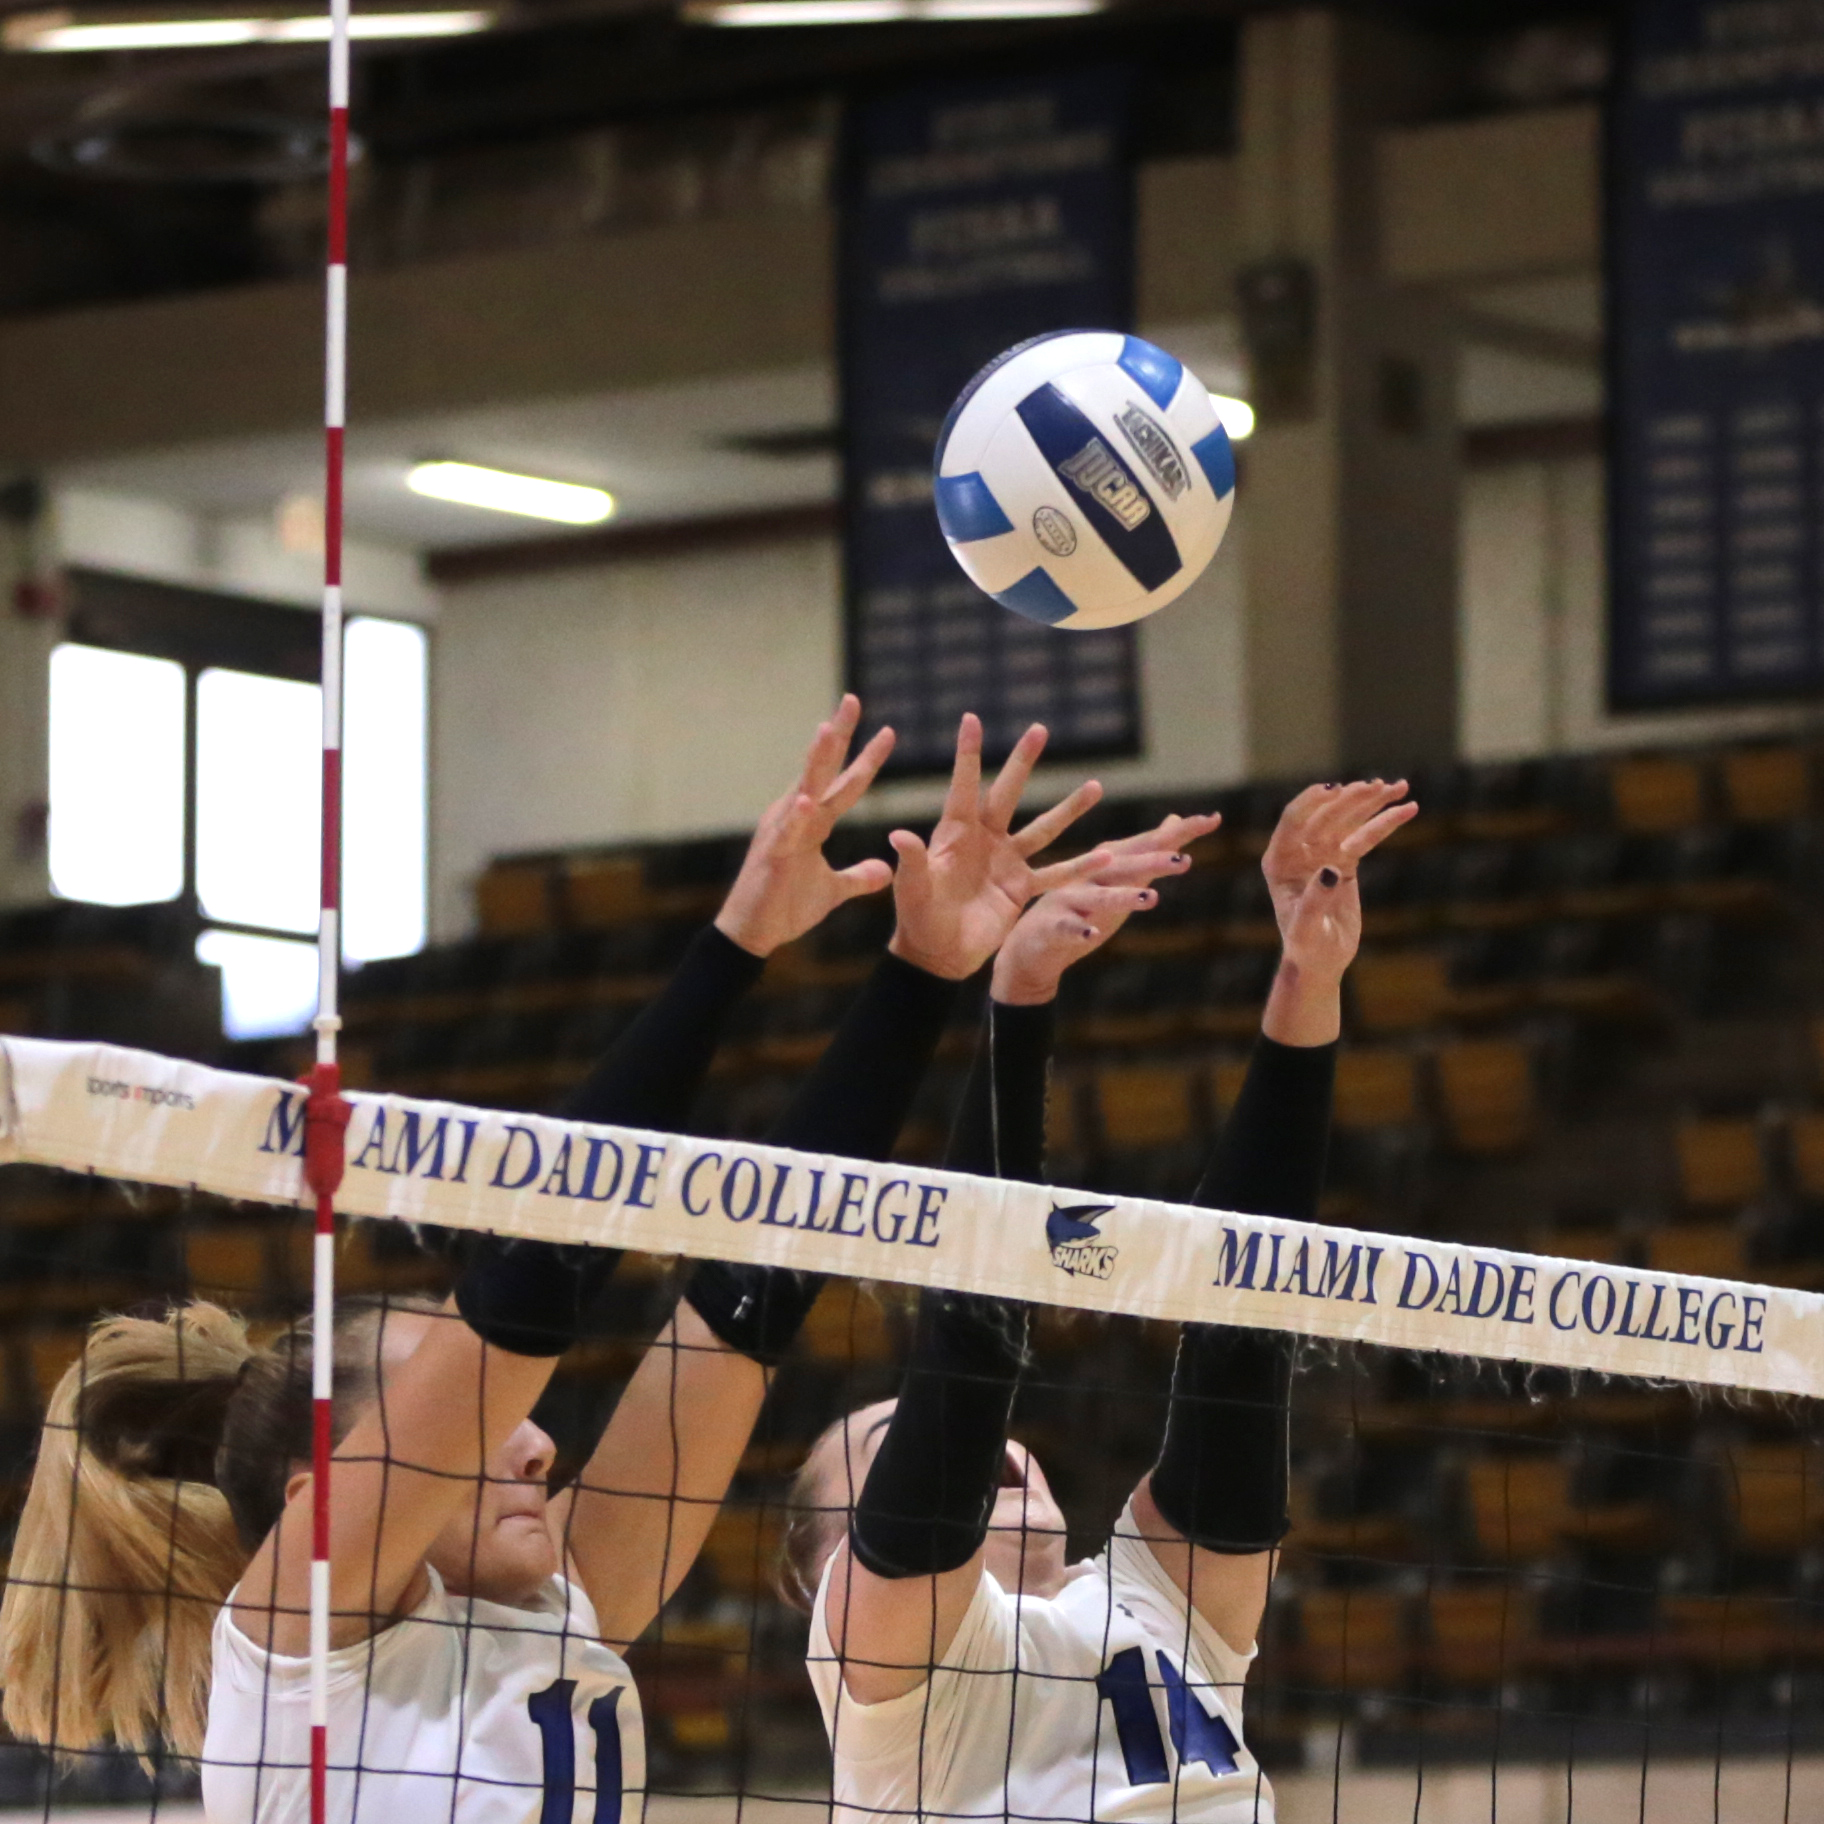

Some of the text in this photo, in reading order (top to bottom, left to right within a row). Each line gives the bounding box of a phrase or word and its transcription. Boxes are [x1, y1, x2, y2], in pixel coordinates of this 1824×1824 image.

[258, 1091, 947, 1247] MAMI DADE COLLEGE
[1052, 1246, 1118, 1280] SHARKS
[1213, 1228, 1768, 1354] MIAMI DADE COLLEGE
[1095, 1646, 1241, 1786] 14
